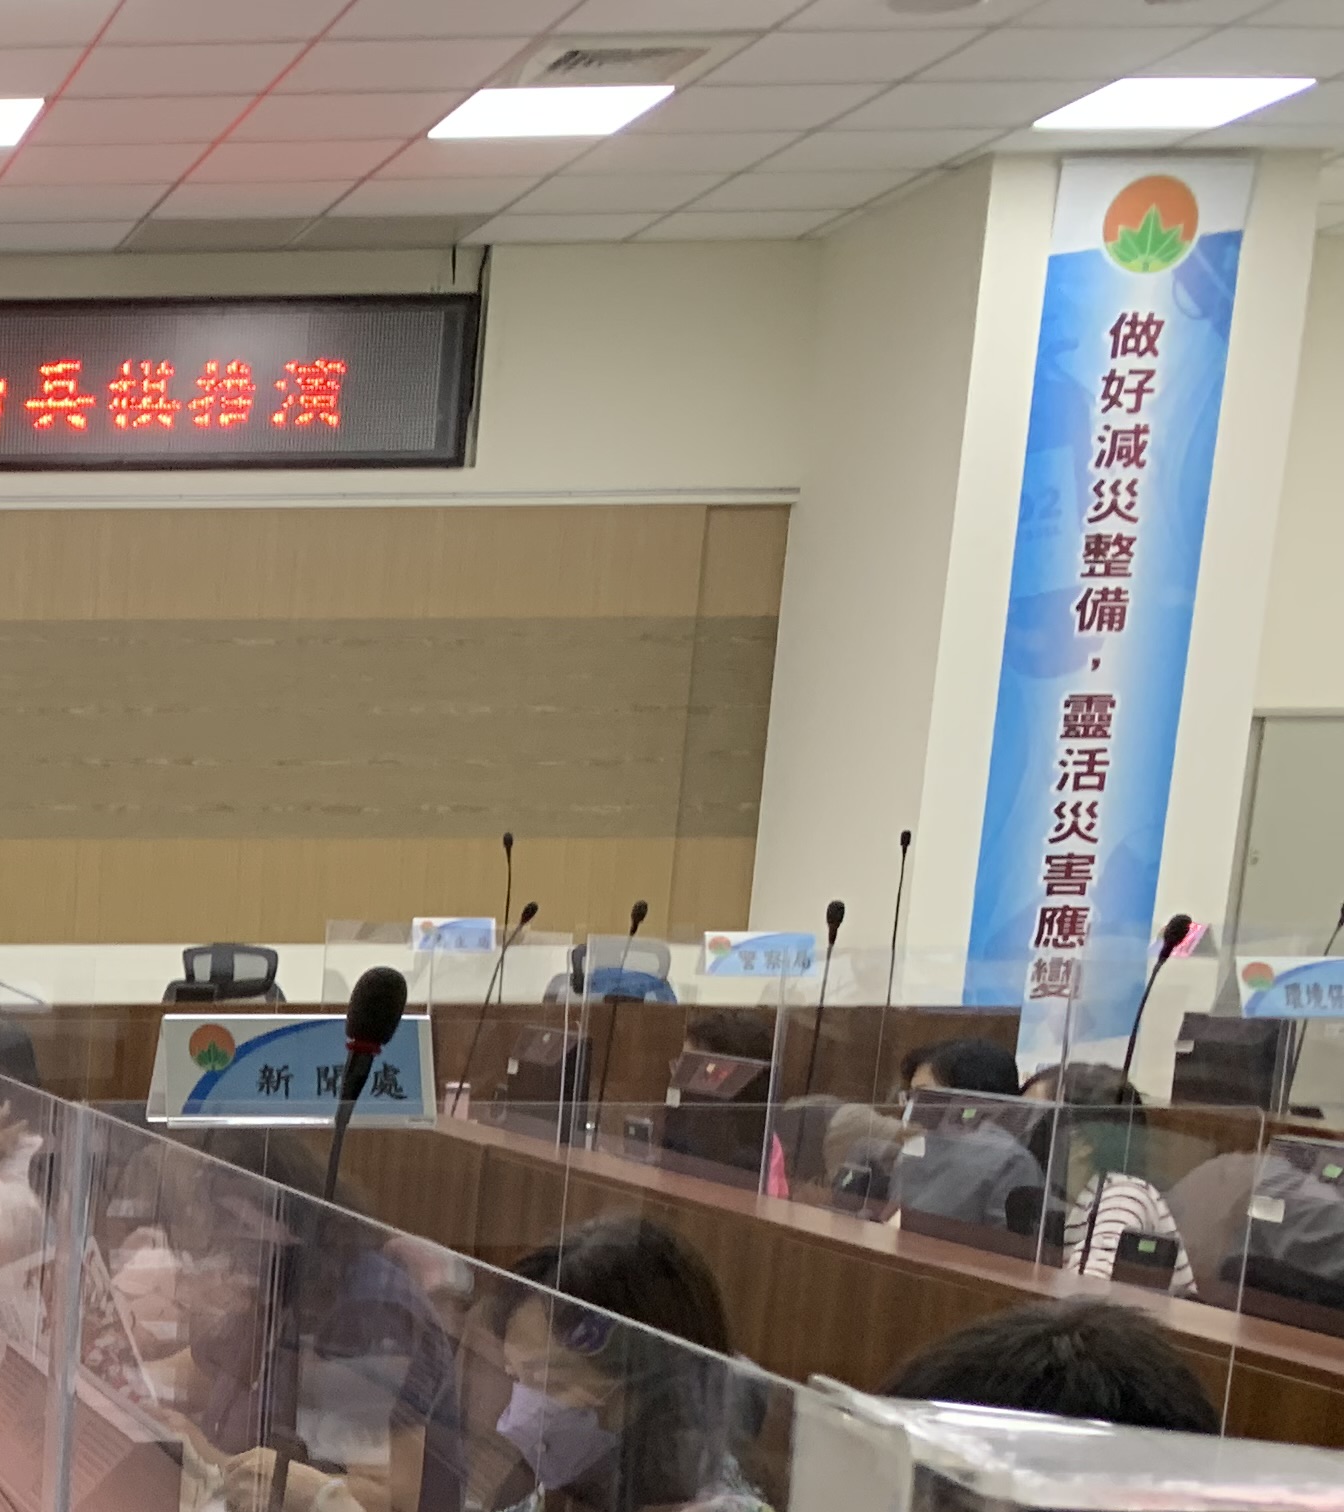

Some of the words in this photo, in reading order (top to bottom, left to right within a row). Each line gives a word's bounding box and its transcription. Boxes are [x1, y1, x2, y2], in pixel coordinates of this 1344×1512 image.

[1029, 311, 1164, 1001] 做好減災整備，靈活災害應變
[255, 1060, 407, 1100] 新聞處
